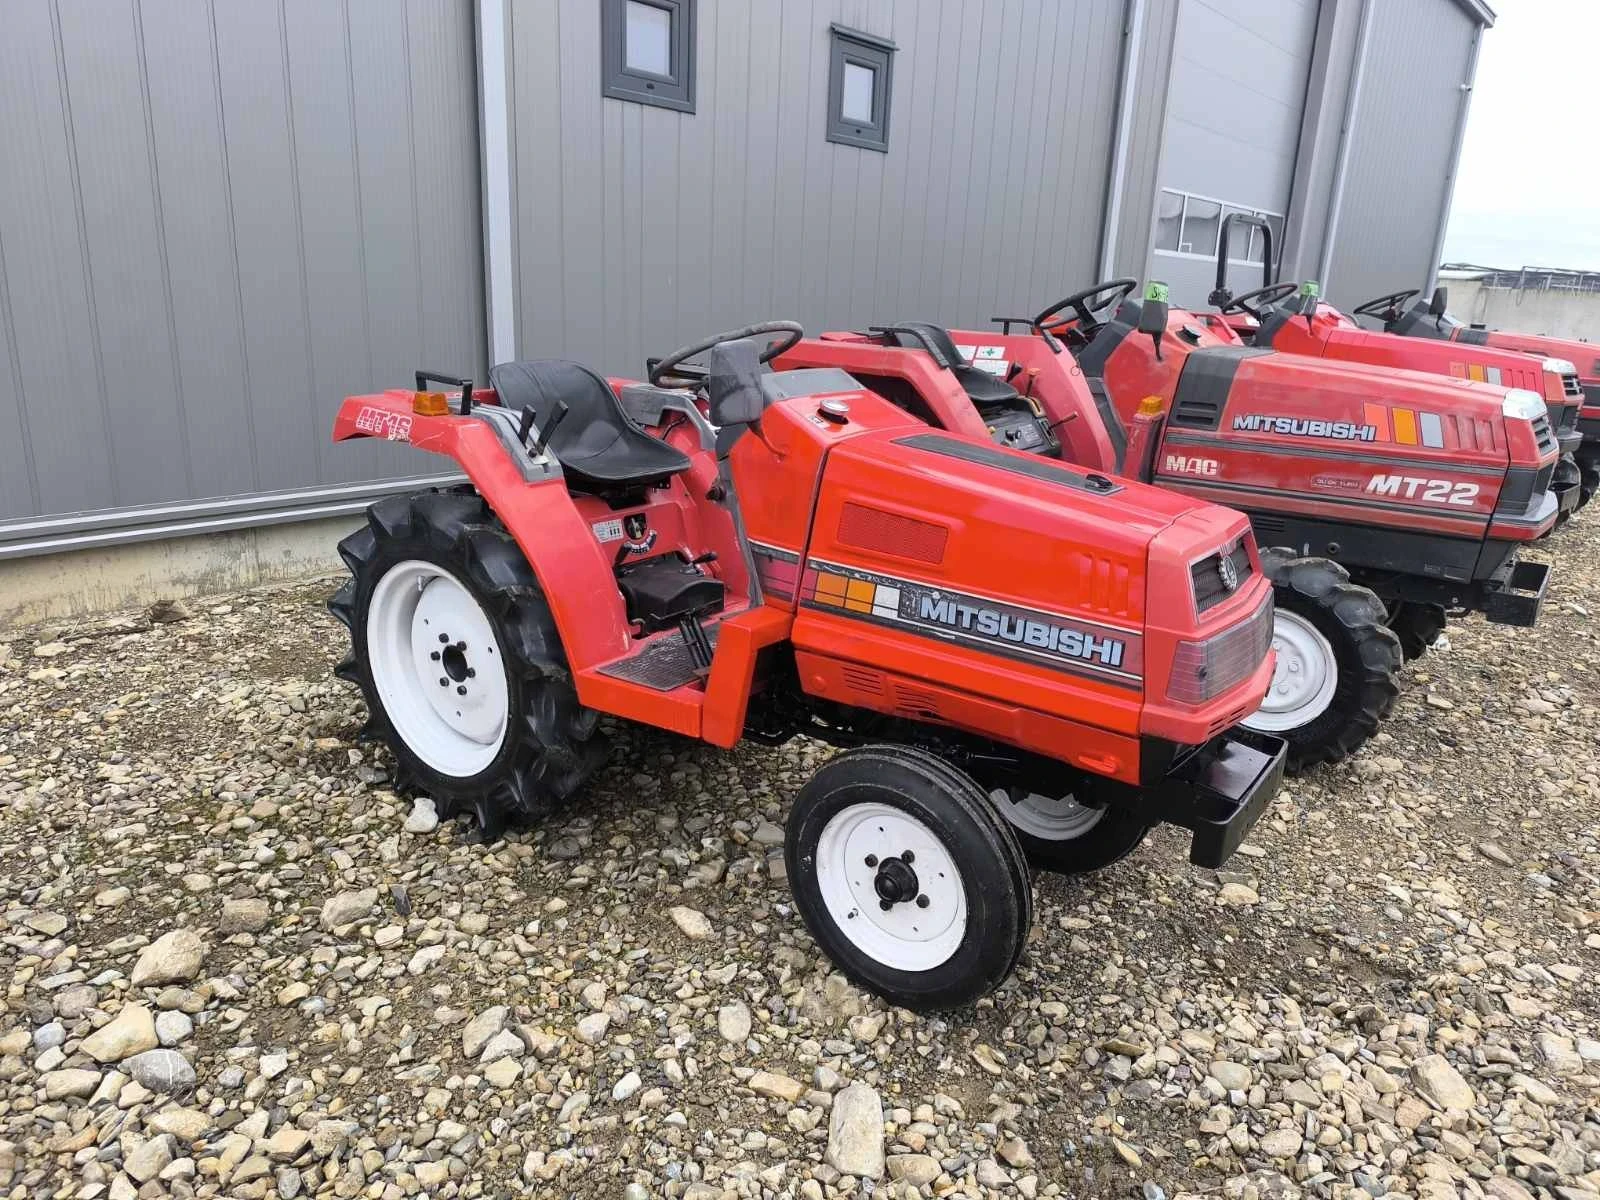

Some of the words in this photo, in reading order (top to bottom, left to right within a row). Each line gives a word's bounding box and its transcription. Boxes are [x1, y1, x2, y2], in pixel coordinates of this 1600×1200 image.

[1232, 414, 1376, 442] MITSUBISHI
[1166, 455, 1218, 476] MAC
[1366, 475, 1479, 506] MT22
[920, 595, 1125, 667] MITSUBISHI
